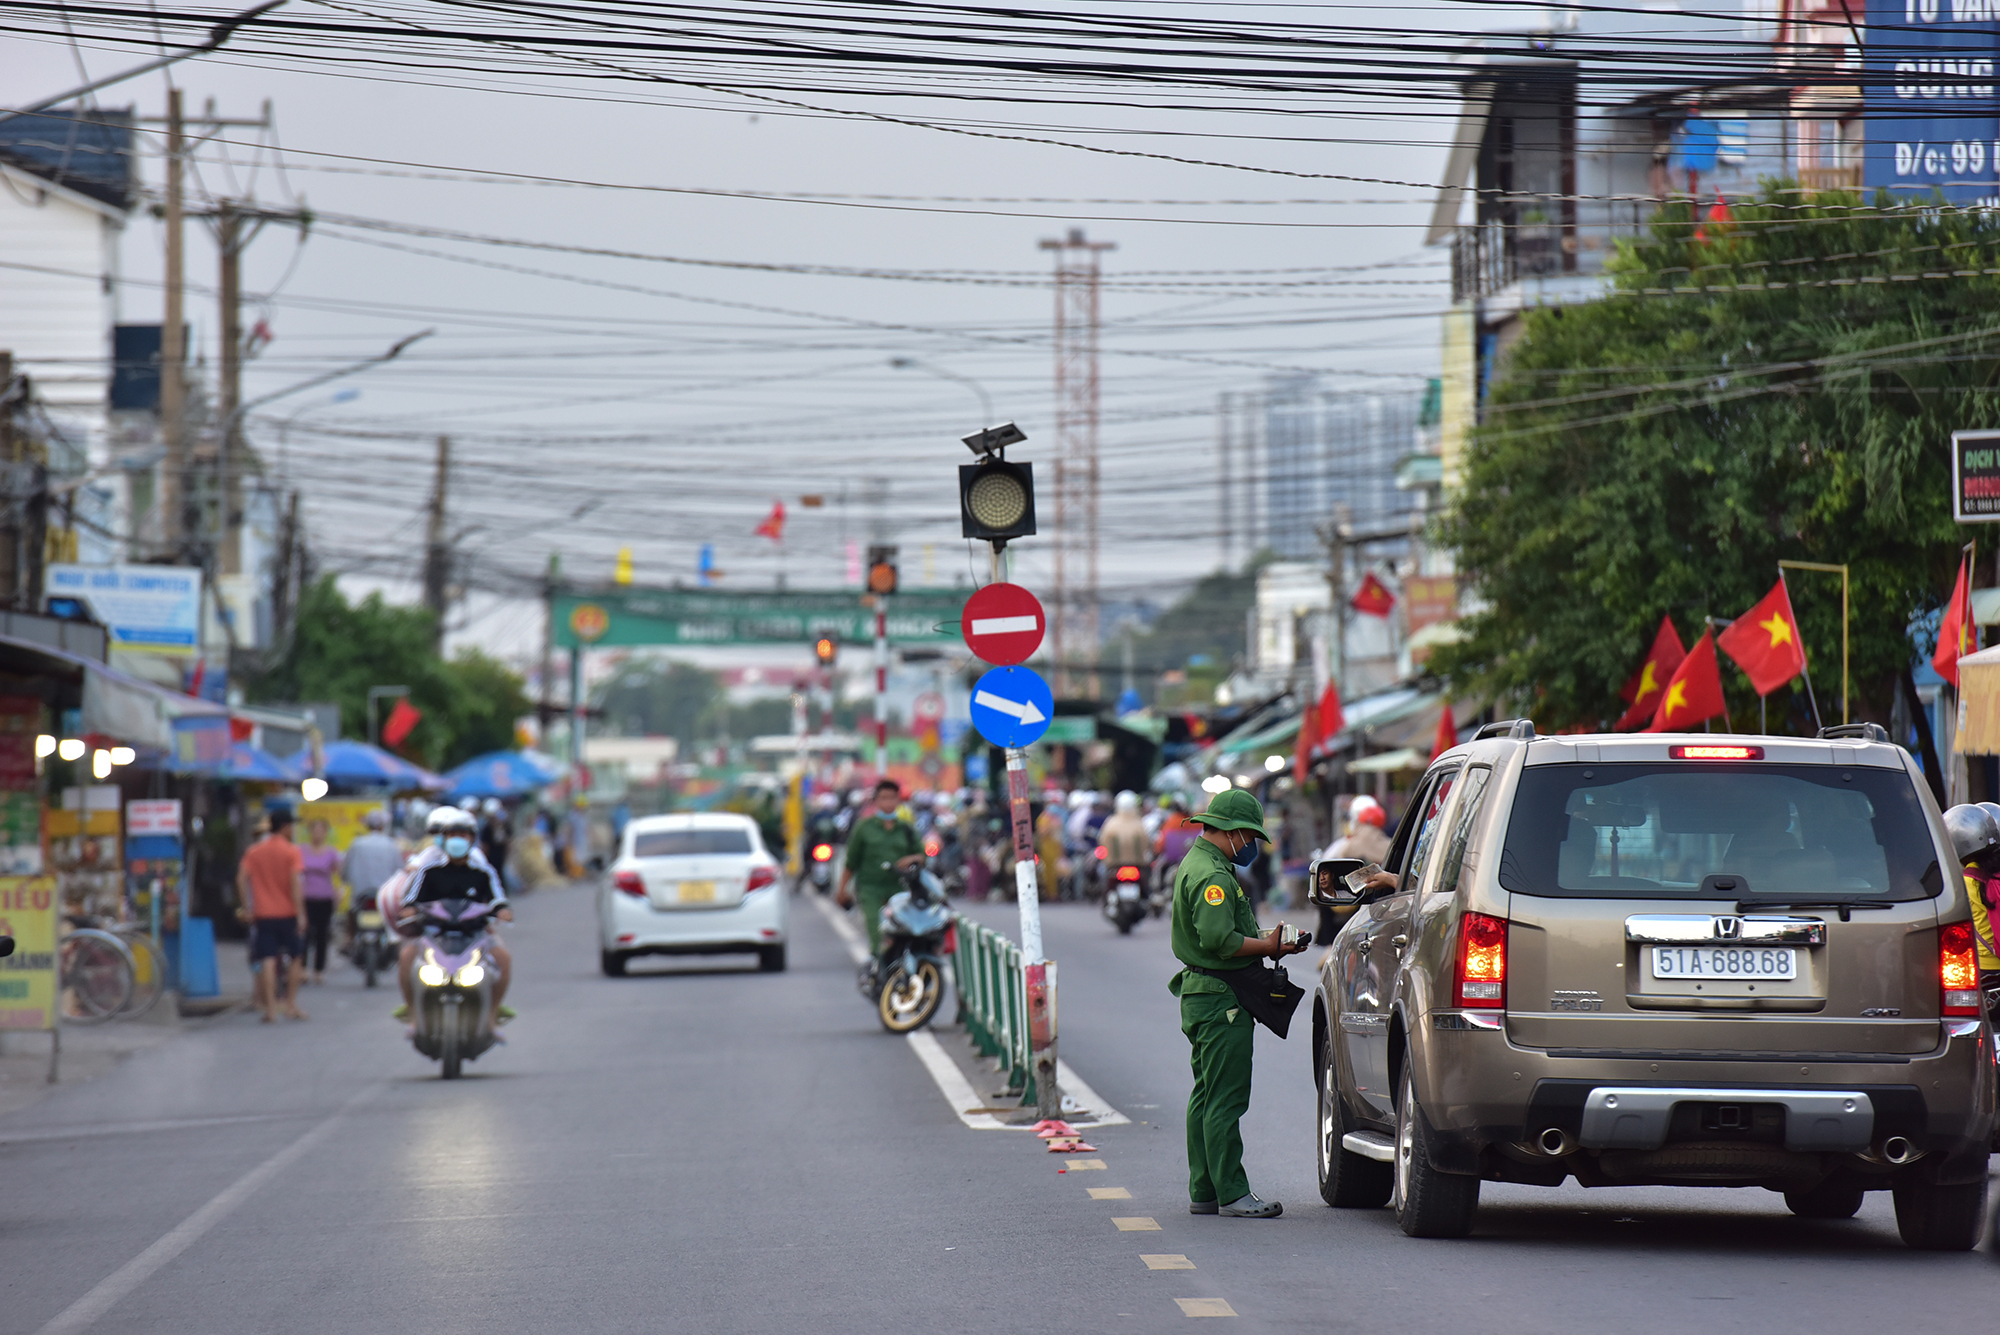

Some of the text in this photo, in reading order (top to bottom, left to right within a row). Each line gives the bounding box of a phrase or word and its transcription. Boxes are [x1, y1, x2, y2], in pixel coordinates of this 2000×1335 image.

[1951, 139, 1985, 175] 99
[1659, 948, 1790, 975] 51A-688.68
[1550, 997, 1604, 1011] PILOT
